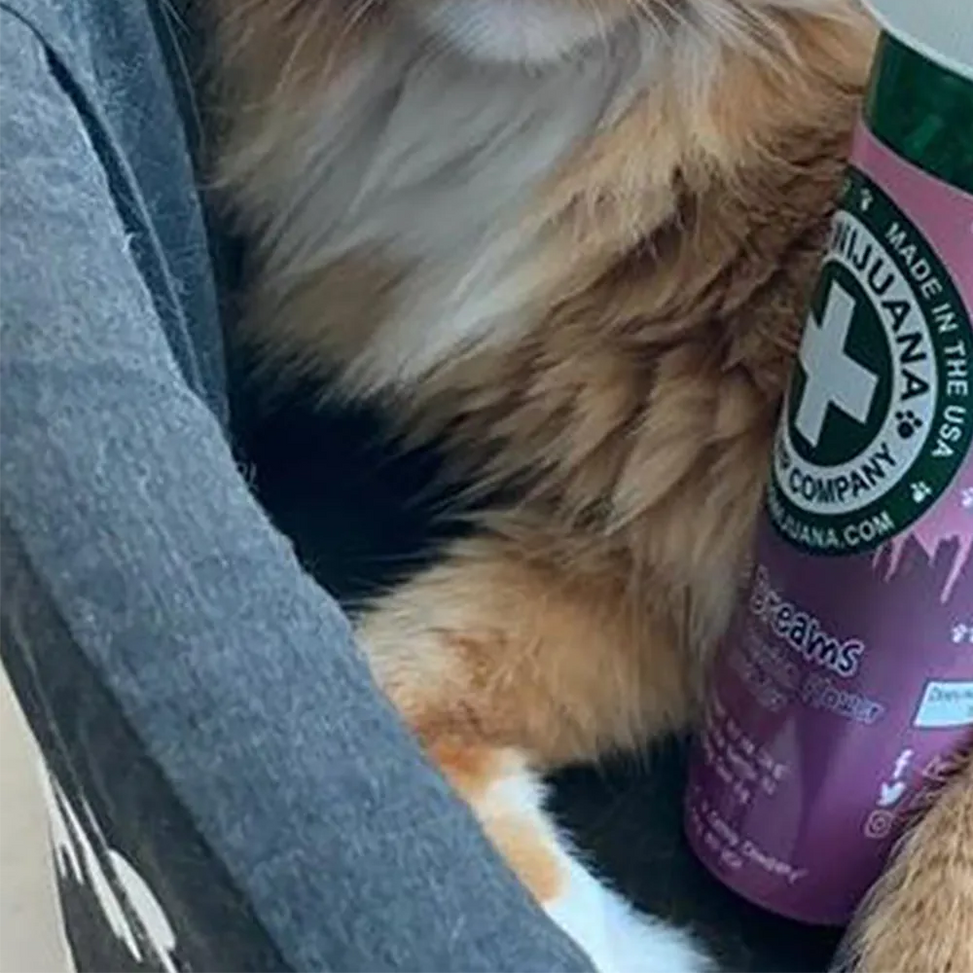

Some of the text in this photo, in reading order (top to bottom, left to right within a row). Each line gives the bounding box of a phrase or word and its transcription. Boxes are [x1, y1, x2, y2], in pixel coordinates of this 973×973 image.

[882, 221, 969, 459] MADE IN THE USA
[788, 442, 897, 503] COMPANY
